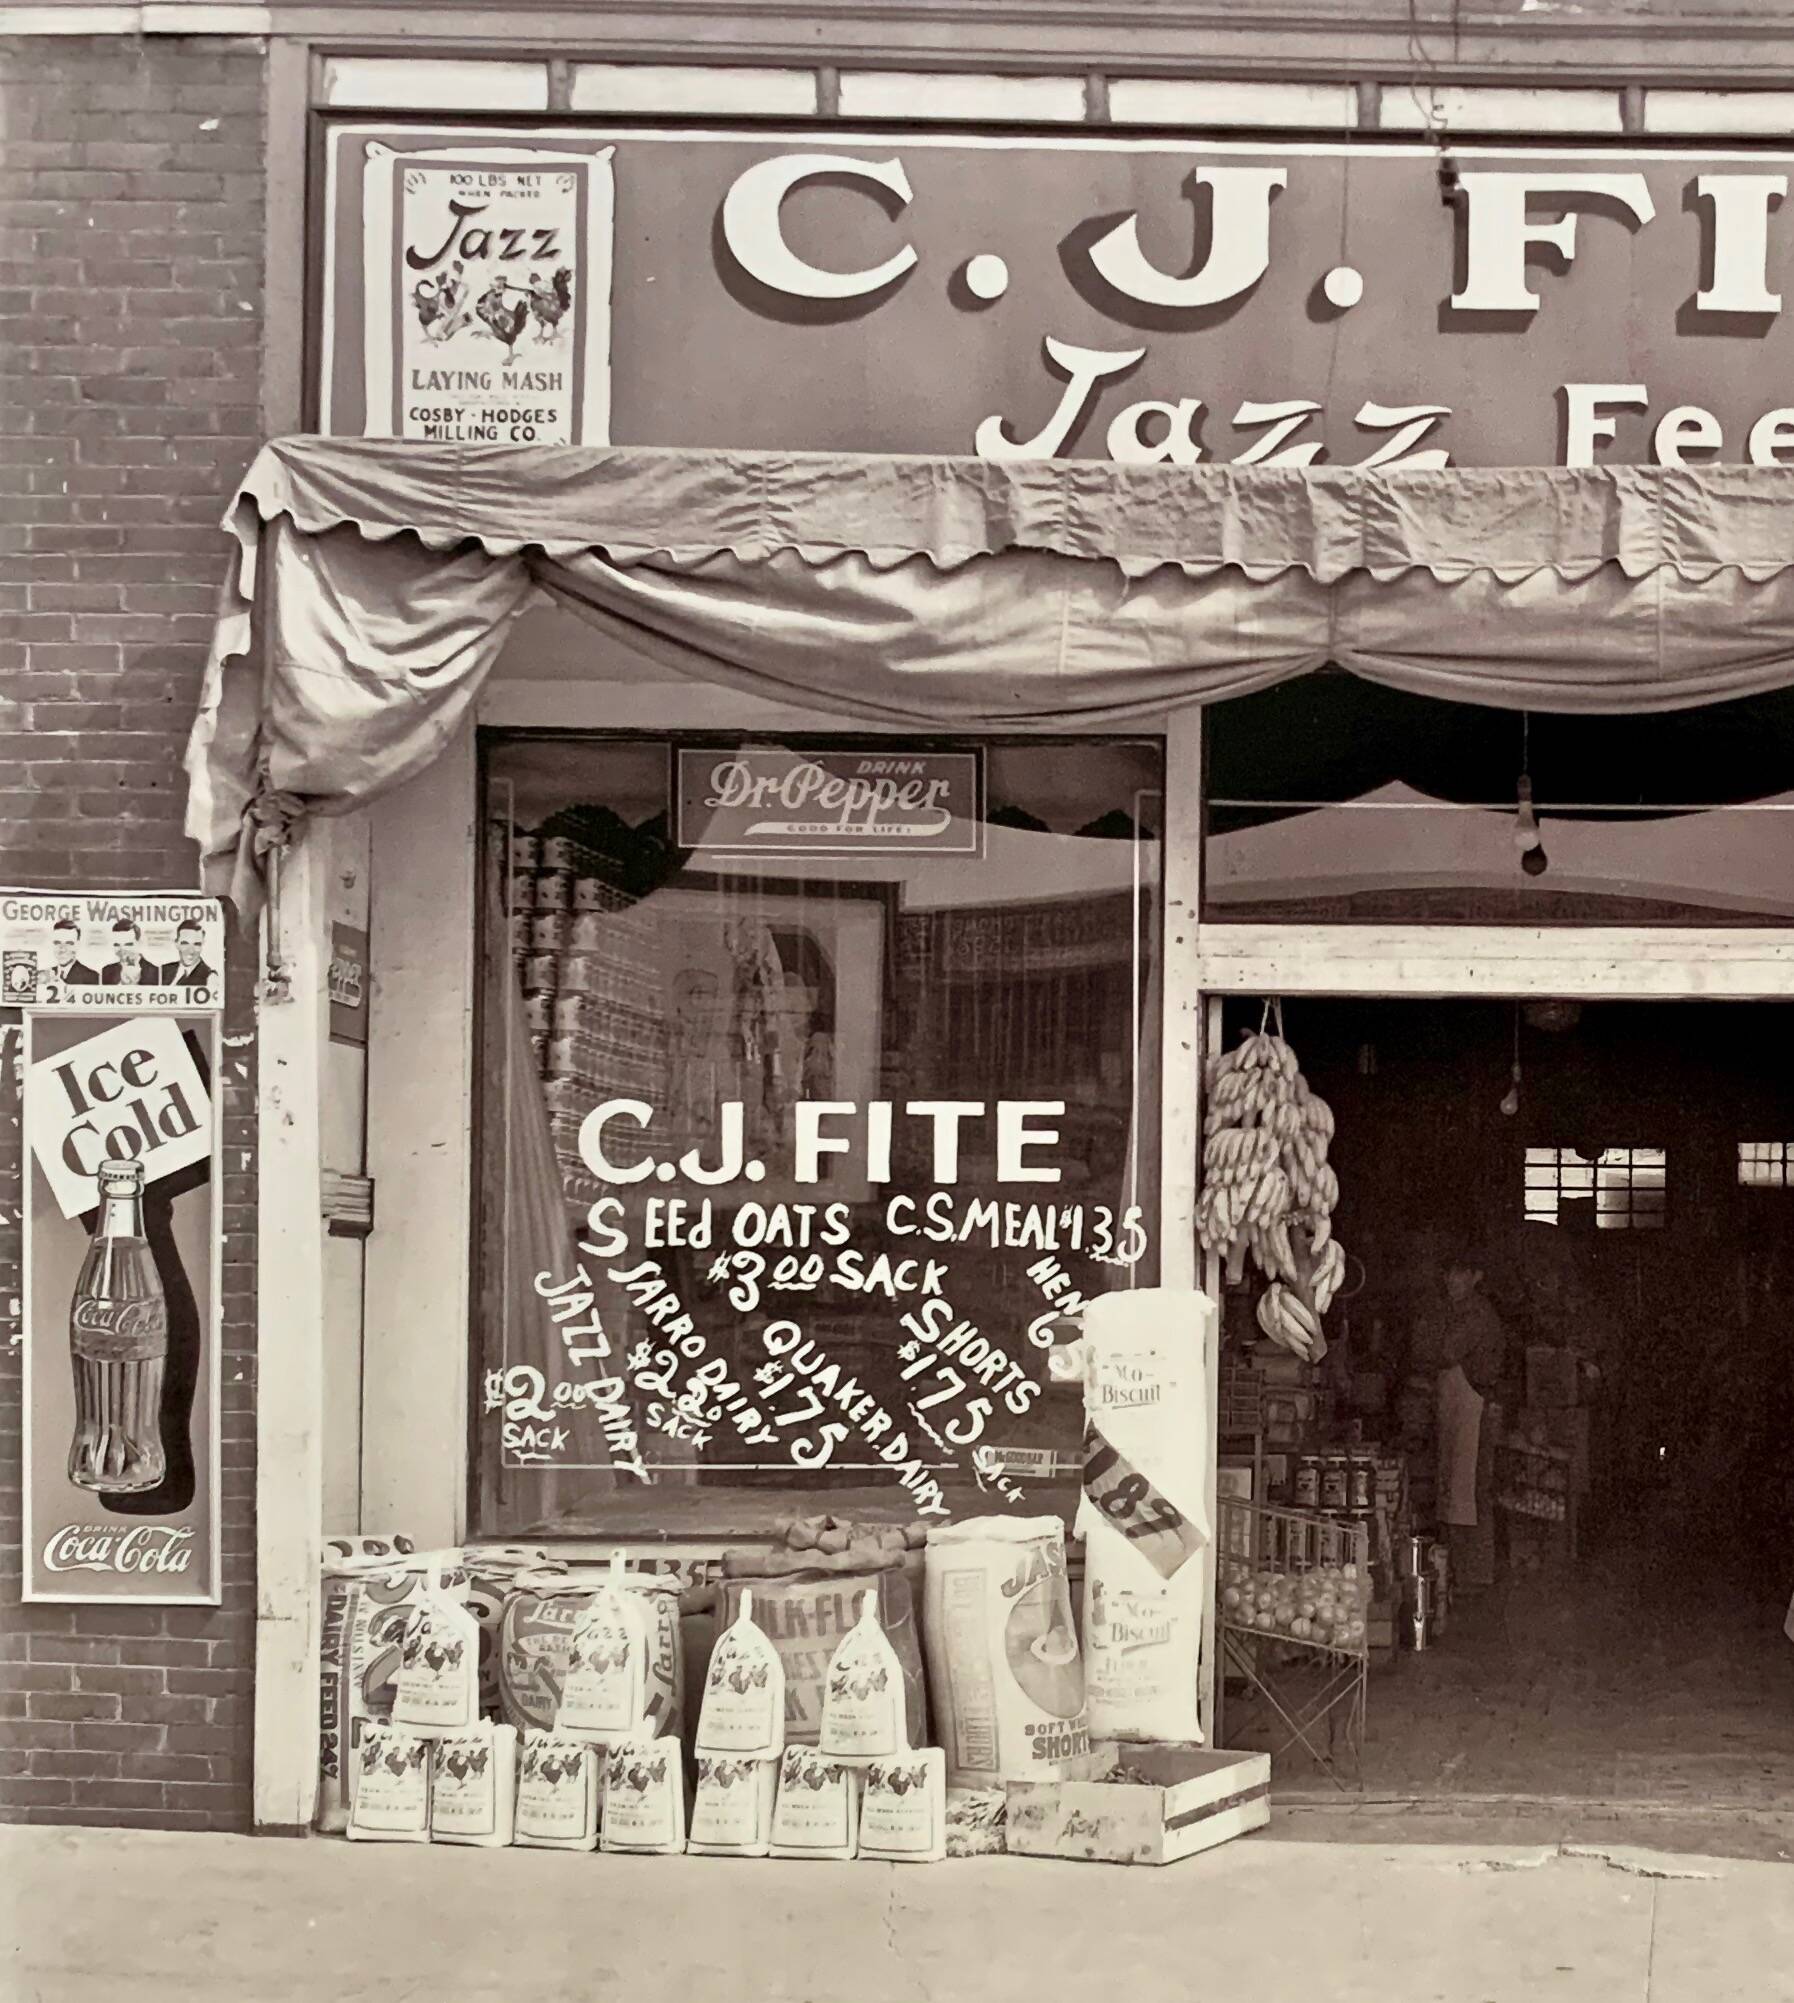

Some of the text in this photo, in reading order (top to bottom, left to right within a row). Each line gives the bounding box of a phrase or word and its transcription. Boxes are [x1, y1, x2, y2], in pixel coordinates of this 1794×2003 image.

[449, 174, 473, 187] 100
[406, 199, 560, 270] Jazz
[412, 368, 563, 392] LAYING MASH
[975, 335, 1794, 470] Jazz Fee
[409, 406, 558, 424] COSBY HODGES
[424, 424, 498, 441] MILLING
[856, 760, 927, 775] DRINK
[836, 823, 864, 833] FOR
[2, 900, 218, 922] GEORGE WASHINGTON
[83, 992, 143, 1006] OUNCES
[150, 992, 178, 1006] FOR
[51, 1049, 158, 1119] Ice
[61, 1081, 203, 1178] Cold
[794, 1099, 1066, 1184] FITE
[732, 1201, 851, 1248] OATS
[829, 1249, 949, 1298] SACK
[1026, 1255, 1091, 1316] HEN
[534, 1263, 657, 1485] JAZZ DAIRY
[900, 1298, 1041, 1414] SHORTS
[696, 1357, 780, 1445] DAIRY
[501, 1423, 570, 1451] SACK
[646, 1402, 713, 1451] SACK
[880, 1431, 951, 1516] DAIRY
[83, 1525, 127, 1534] DRINK
[321, 1594, 347, 1668] DAIRY
[321, 1671, 338, 1730] FEED
[1025, 1720, 1065, 1737] SOFT
